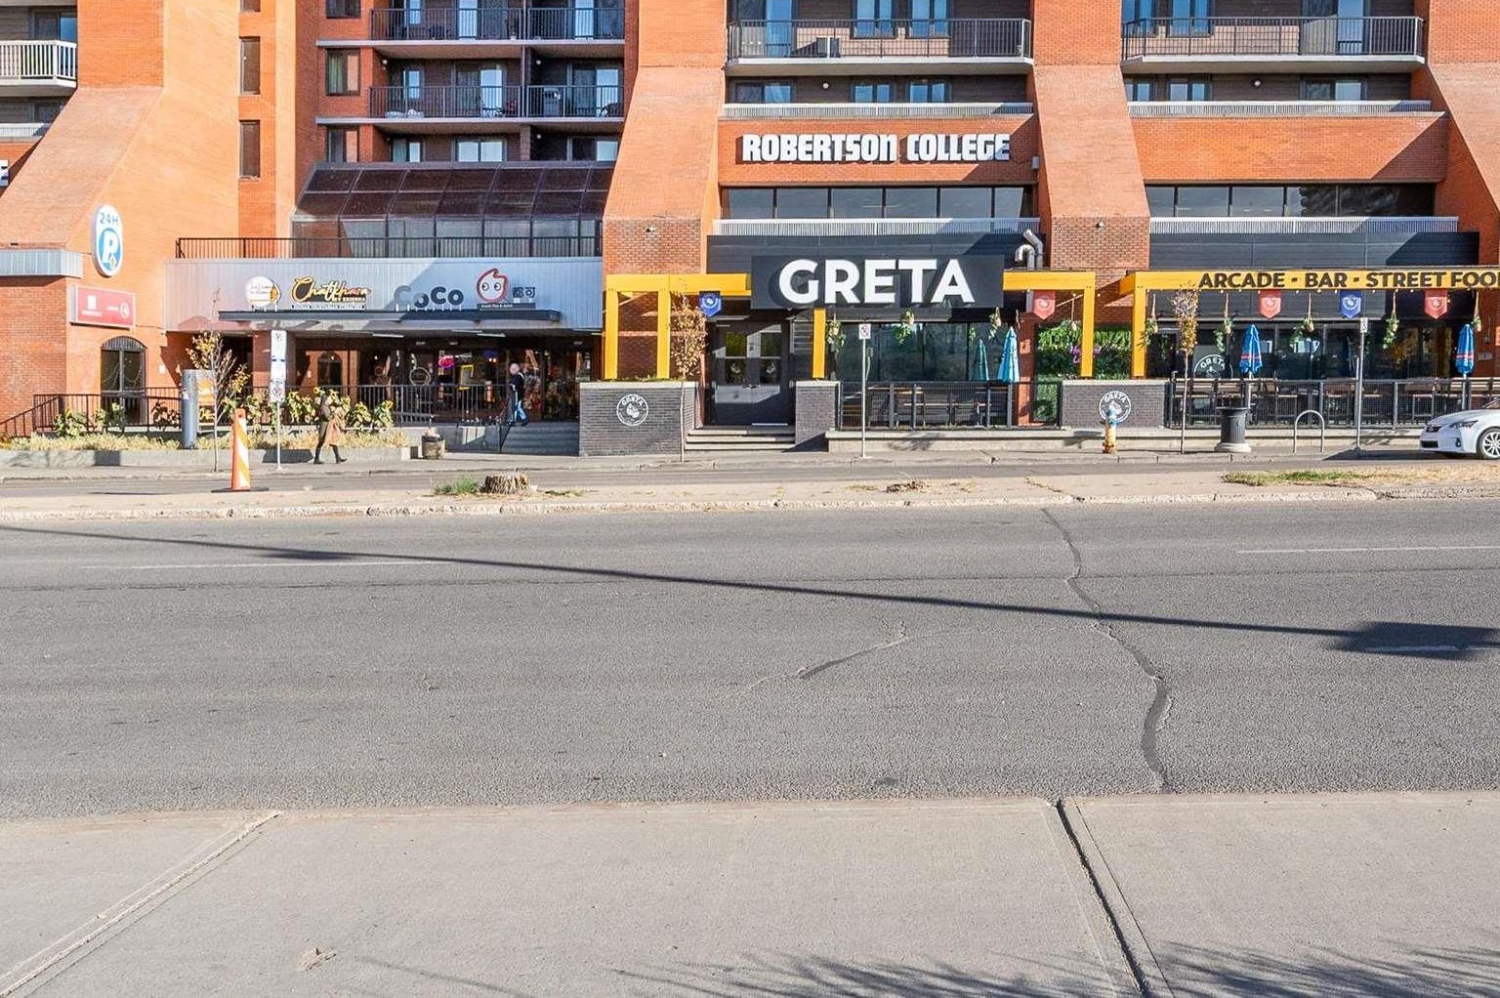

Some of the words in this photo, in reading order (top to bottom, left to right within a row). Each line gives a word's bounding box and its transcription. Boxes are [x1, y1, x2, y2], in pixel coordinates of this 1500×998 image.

[743, 134, 898, 162] ROBERTSON
[907, 134, 1010, 161] COLLEGE
[100, 212, 118, 225] 24H
[779, 259, 975, 303] GRETA
[1200, 273, 1285, 288] ARCADE
[1305, 273, 1347, 287] BAR
[1366, 272, 1446, 287] STREET
[1451, 272, 1500, 287] FOO
